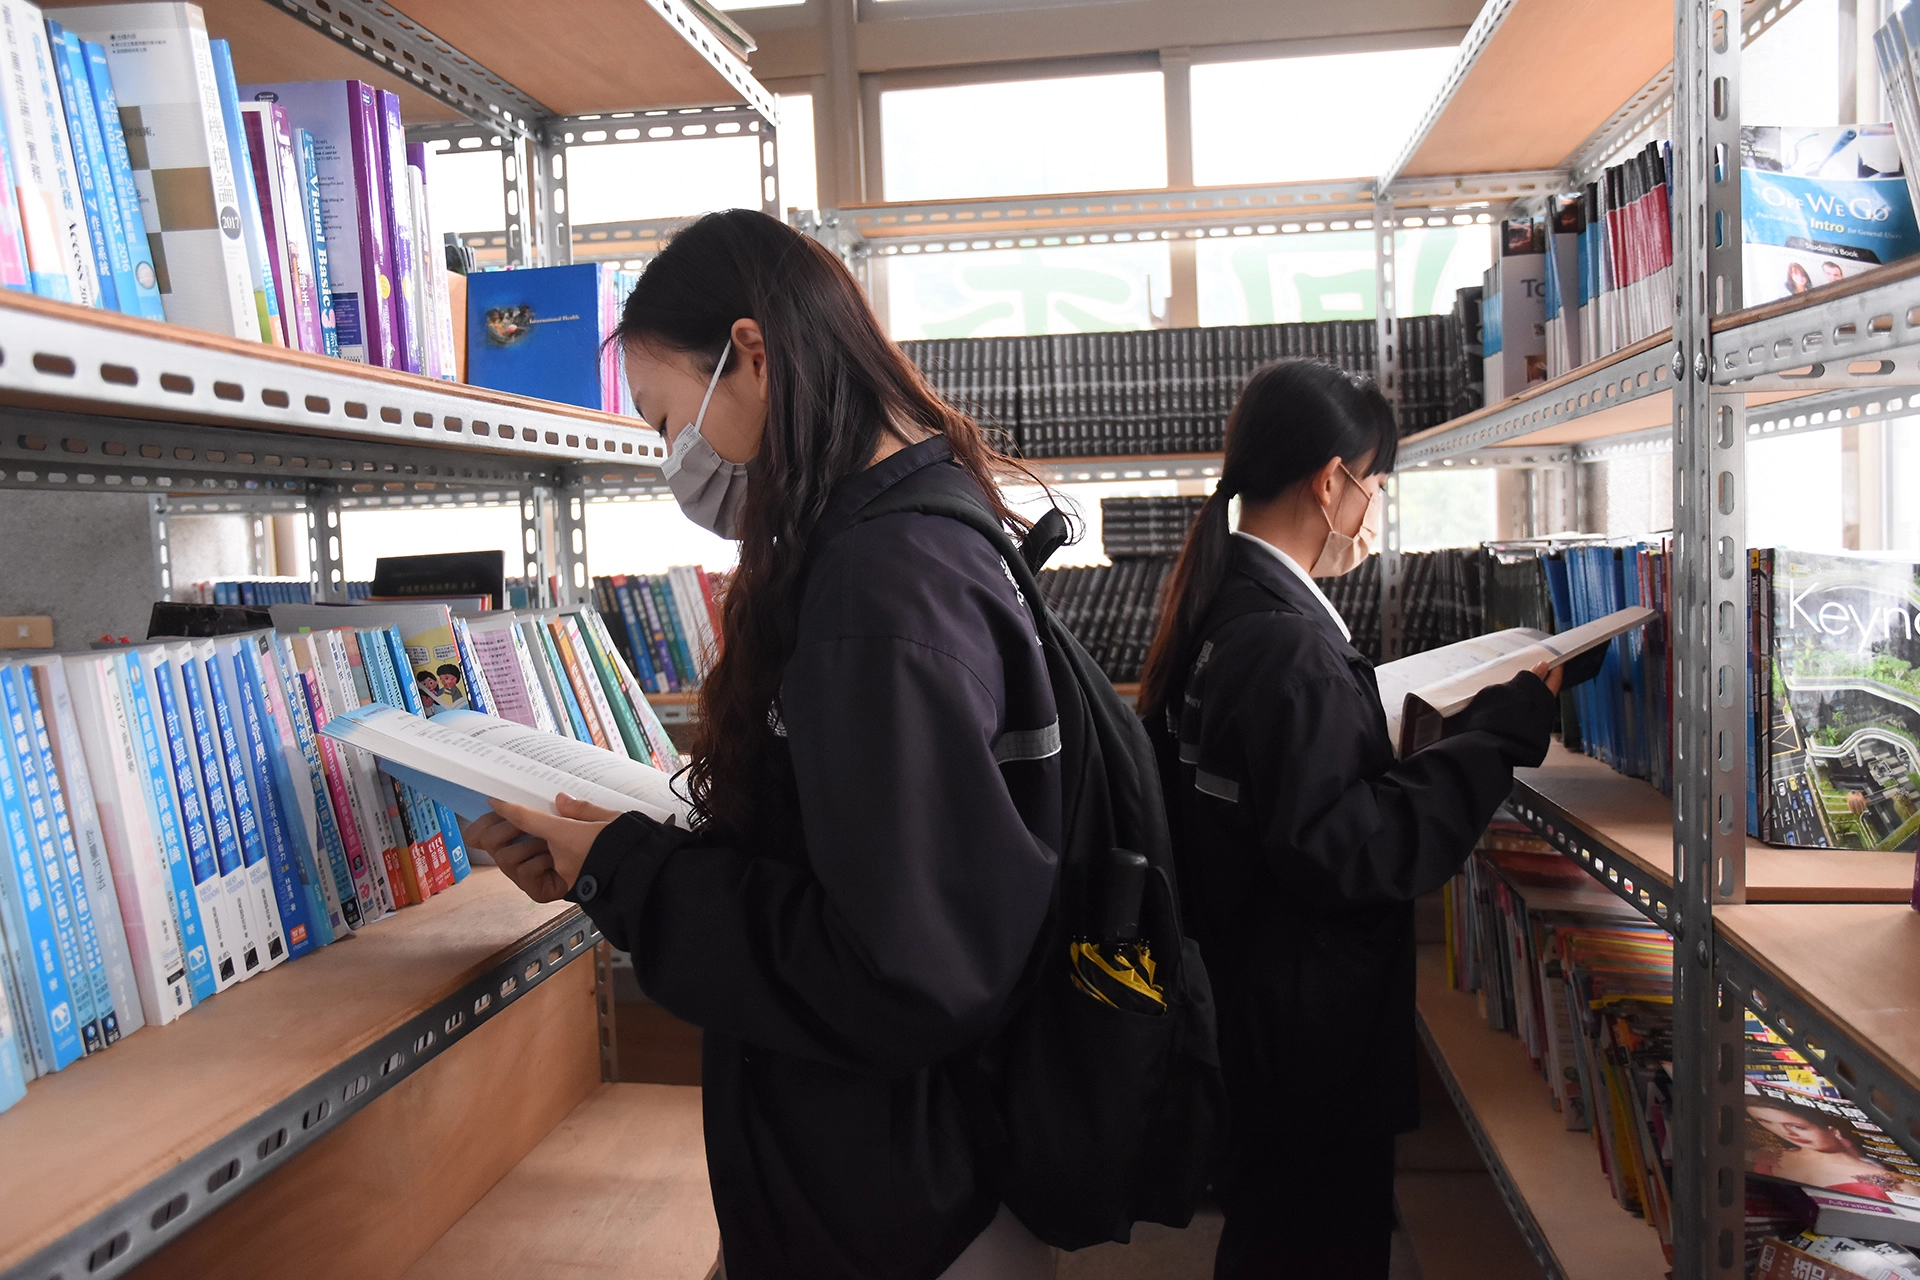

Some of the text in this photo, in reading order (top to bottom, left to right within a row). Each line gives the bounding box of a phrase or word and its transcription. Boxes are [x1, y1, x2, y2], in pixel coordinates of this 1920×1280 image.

[73, 120, 94, 190] CentOS
[87, 199, 98, 212] 7
[81, 79, 107, 153] AUTODESK
[100, 163, 113, 193] 3DS
[108, 197, 123, 235] MAX
[117, 242, 132, 272] 2016
[105, 89, 120, 124] 3ds
[115, 129, 130, 170] Max
[124, 177, 139, 213] 2014
[222, 217, 240, 229] 2017
[309, 175, 326, 243] Visual
[1810, 217, 1845, 233] Intro
[1857, 228, 1883, 238] General
[317, 248, 332, 307] Basic
[1805, 242, 1859, 258] Student's Book
[529, 315, 561, 325] International
[1790, 578, 1920, 654] Keyn
[113, 692, 126, 728] 2017
[244, 681, 267, 763] 資訊管理
[166, 708, 206, 851] 計算機概論
[194, 703, 231, 843] 計算機概論
[217, 699, 255, 835] 計算機概論
[317, 713, 345, 793] PhtoImpact
[153, 775, 181, 865] 計算機概論
[9, 809, 42, 912] 計算機概論
[279, 884, 292, 918] SYSTEM
[1828, 1200, 1884, 1212] Advanced
